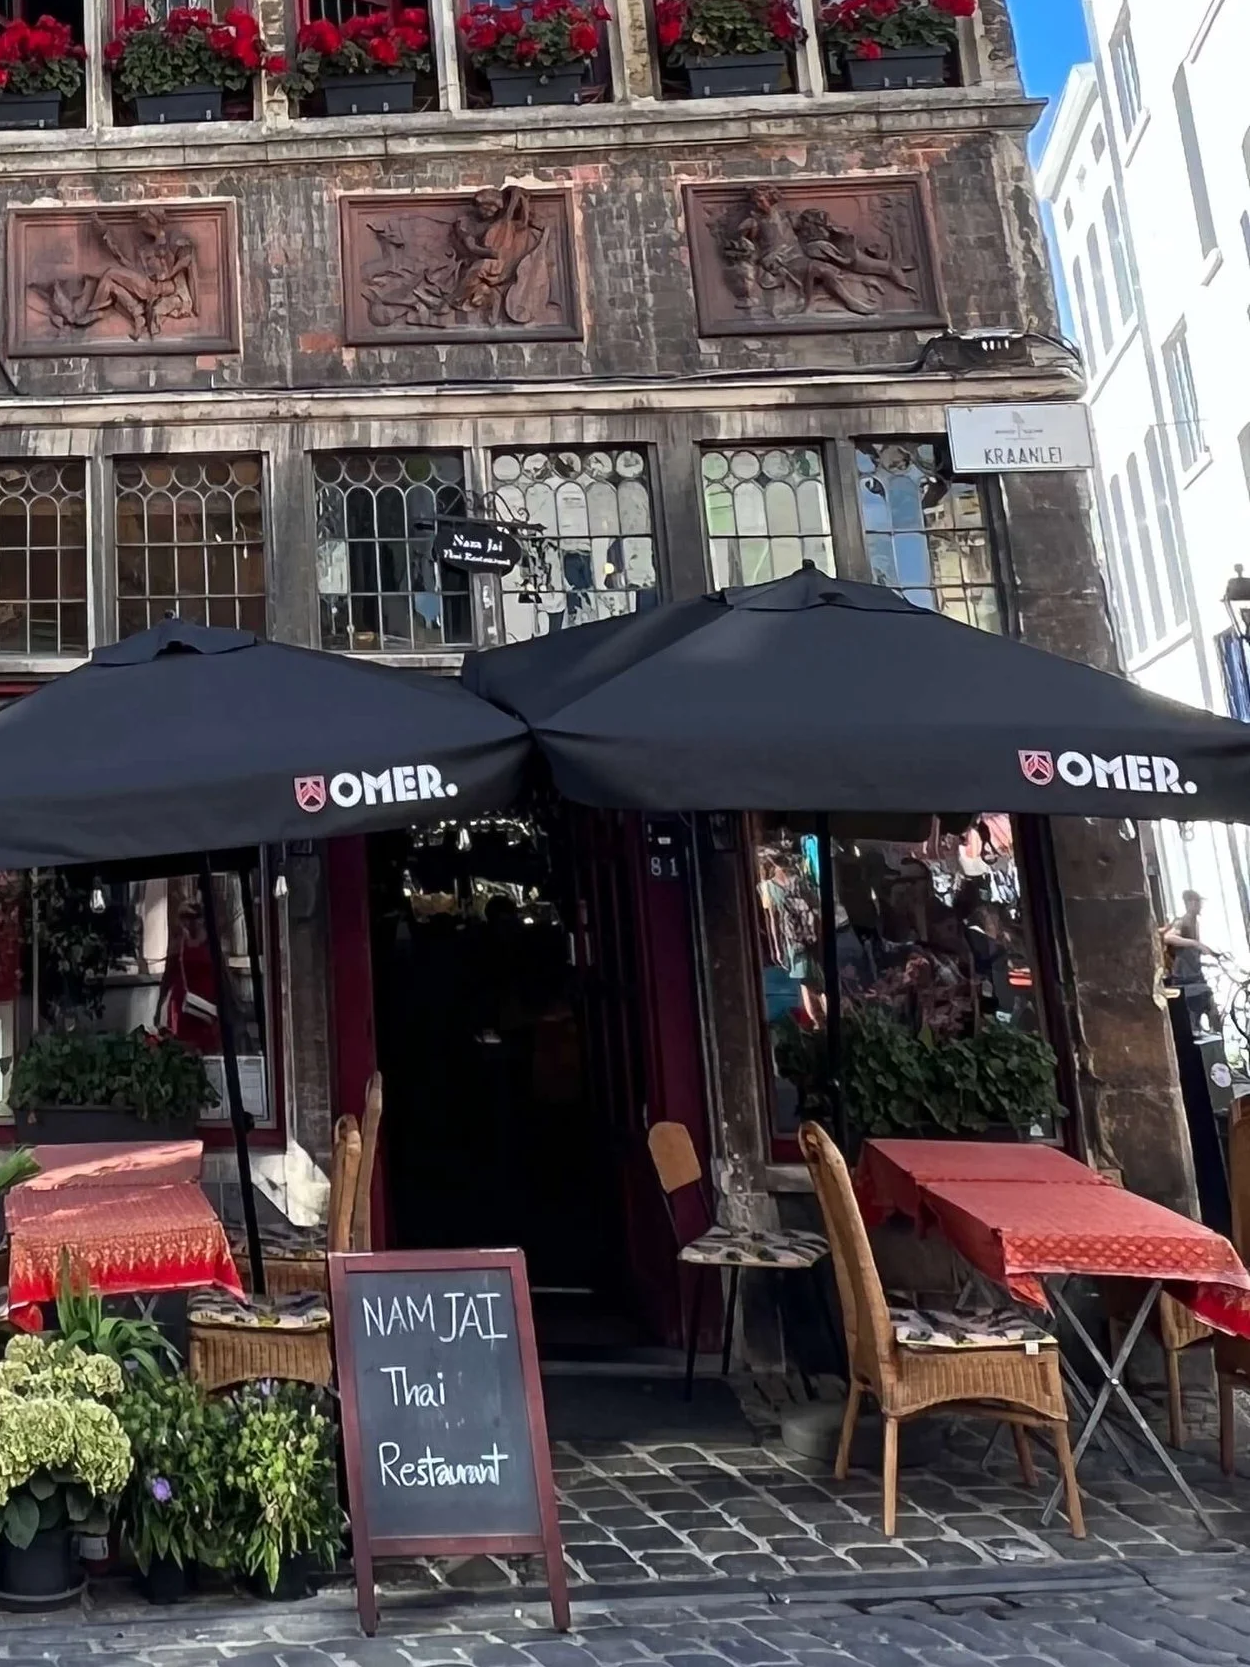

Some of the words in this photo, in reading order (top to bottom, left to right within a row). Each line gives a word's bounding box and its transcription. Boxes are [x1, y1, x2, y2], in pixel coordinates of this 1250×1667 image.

[983, 446, 1062, 465] KRAANLEI
[452, 533, 482, 549] Nam
[487, 537, 503, 553] Jai
[650, 856, 680, 876] 81
[362, 1292, 436, 1337] NAM
[438, 1292, 509, 1343] JAI
[379, 1366, 446, 1407] Thai
[377, 1441, 509, 1487] Restaurant
